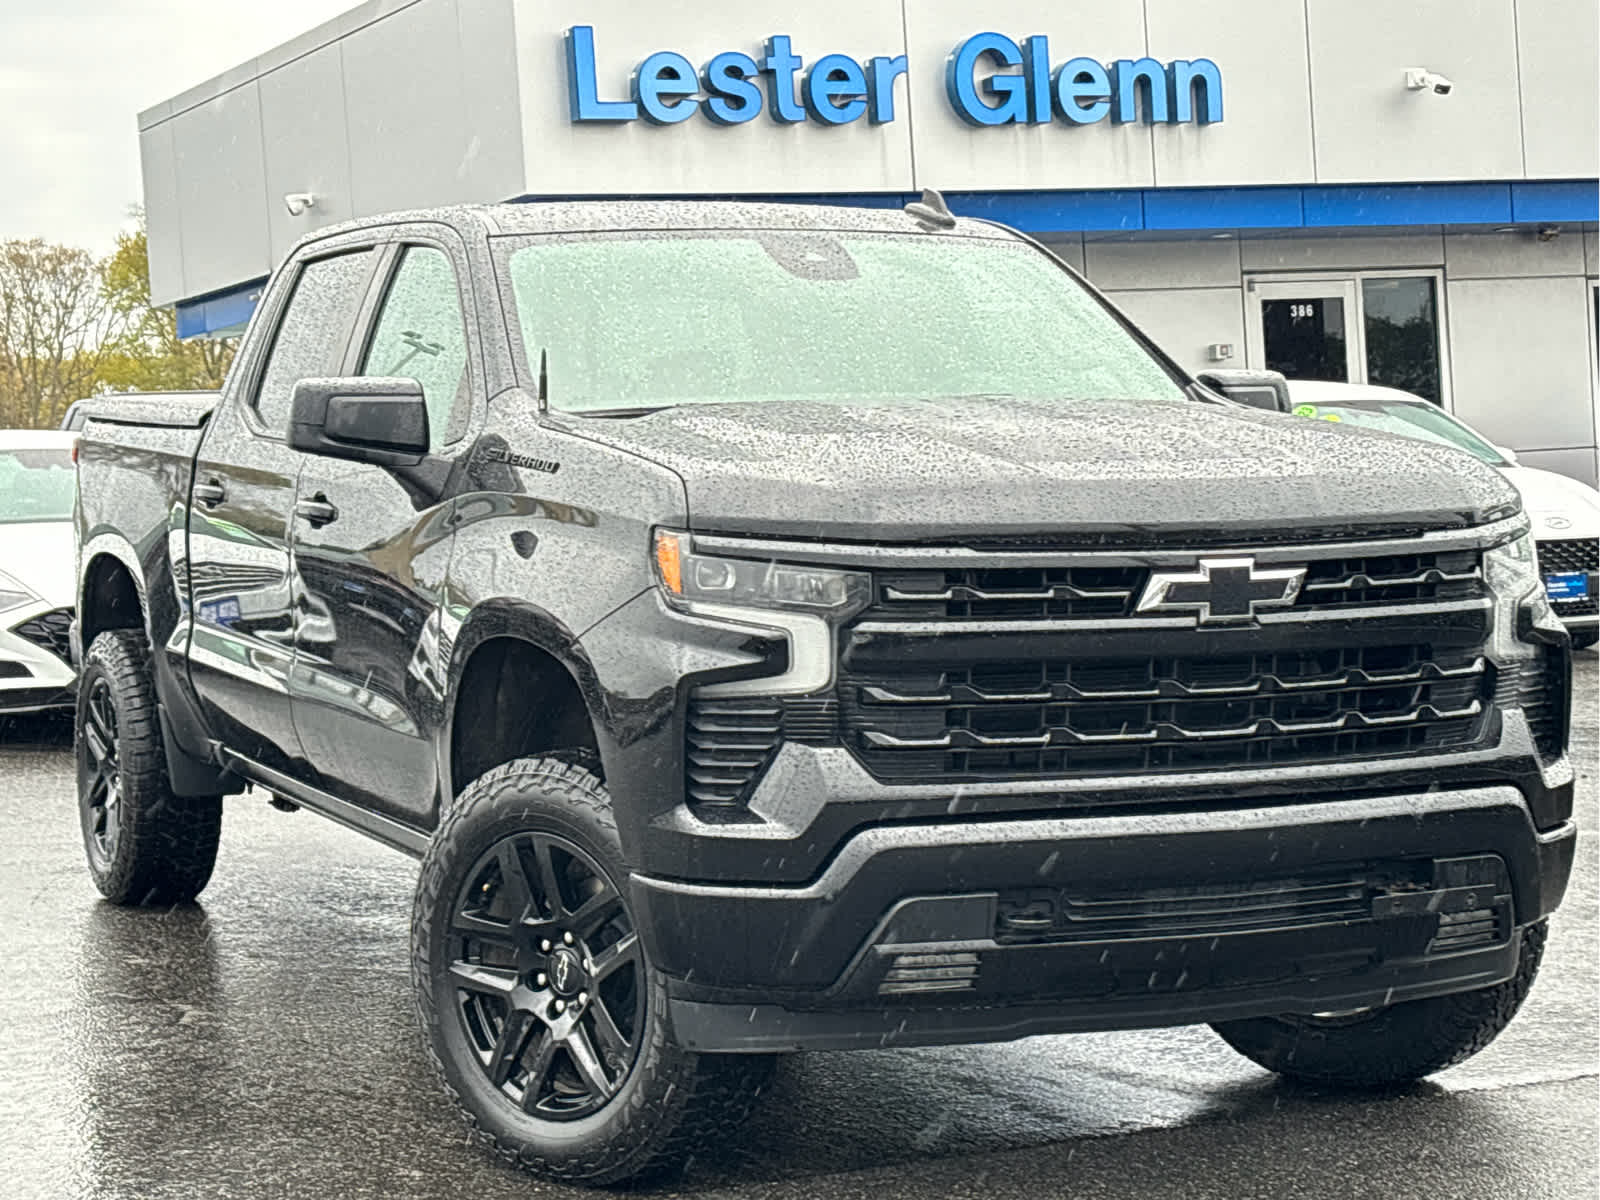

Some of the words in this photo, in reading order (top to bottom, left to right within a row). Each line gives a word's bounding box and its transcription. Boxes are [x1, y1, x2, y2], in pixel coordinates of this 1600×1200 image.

[564, 26, 907, 123] Lester
[946, 32, 1222, 126] Glenn
[1290, 304, 1313, 317] 386
